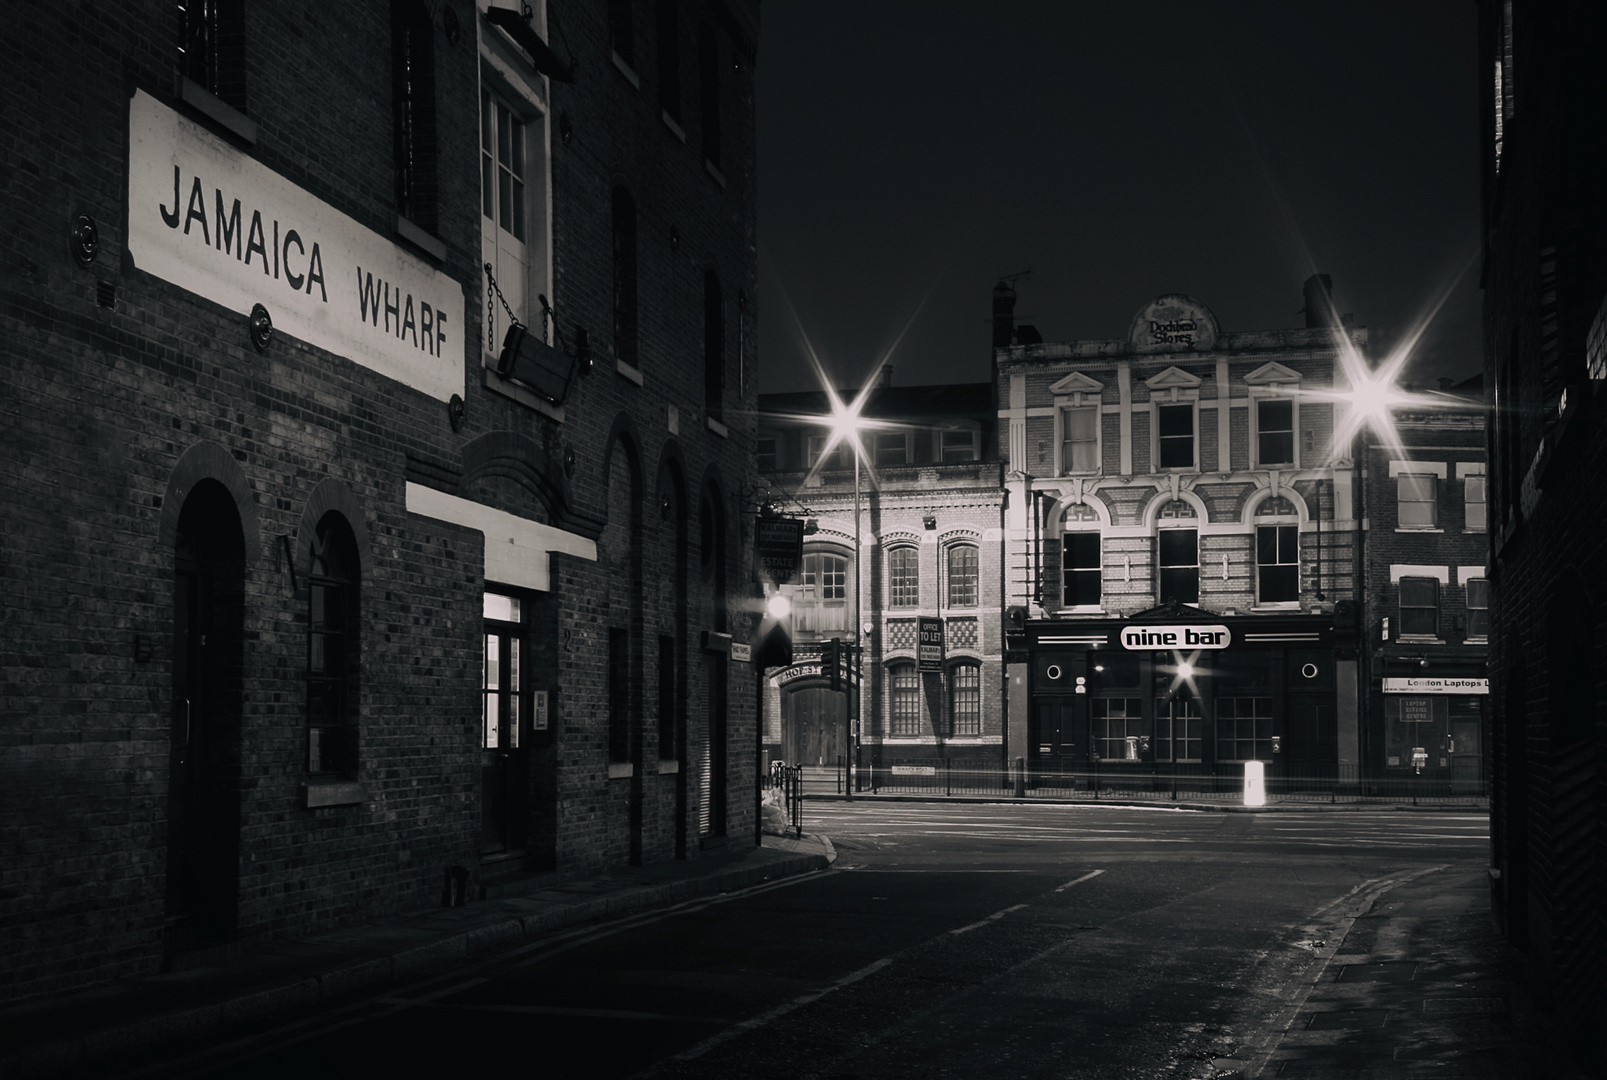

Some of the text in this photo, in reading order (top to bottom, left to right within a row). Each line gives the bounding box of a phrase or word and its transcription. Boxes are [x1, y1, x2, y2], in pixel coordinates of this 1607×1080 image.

[159, 165, 447, 358] JAMAICA WHARF
[760, 556, 794, 567] ESTATE
[757, 568, 796, 579] AGENTS
[923, 623, 939, 632] OFFICE
[920, 631, 941, 642] TO LET
[1126, 628, 1226, 646] nine bar
[785, 667, 804, 679] HOP
[1444, 680, 1481, 688] Laptops
